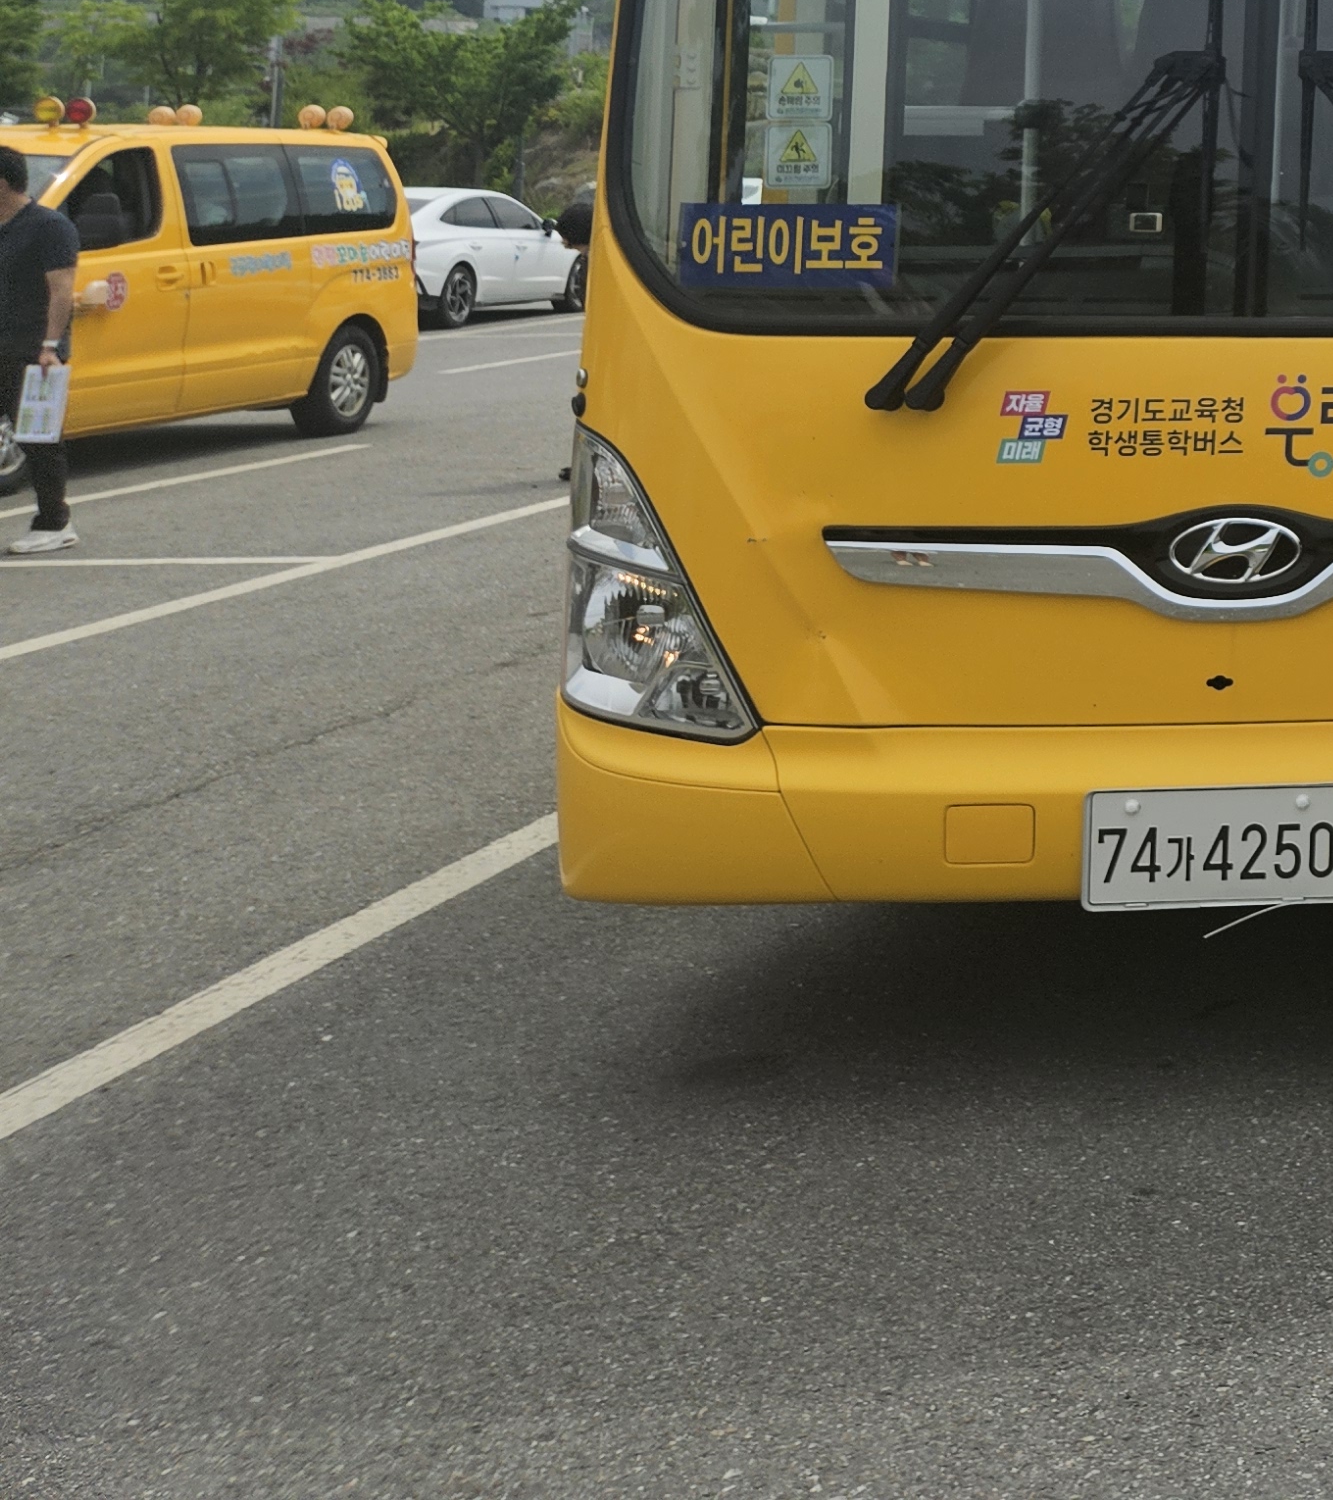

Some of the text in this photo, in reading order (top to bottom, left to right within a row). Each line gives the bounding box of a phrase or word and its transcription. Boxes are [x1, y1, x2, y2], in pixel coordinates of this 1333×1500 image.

[692, 215, 883, 275] 어린이보호
[1006, 393, 1045, 413] 자율
[1090, 397, 1245, 425] 경기도교육청
[1024, 417, 1064, 437] 균형
[1002, 440, 1042, 460] 미래
[1088, 430, 1244, 458] 학생통학버스
